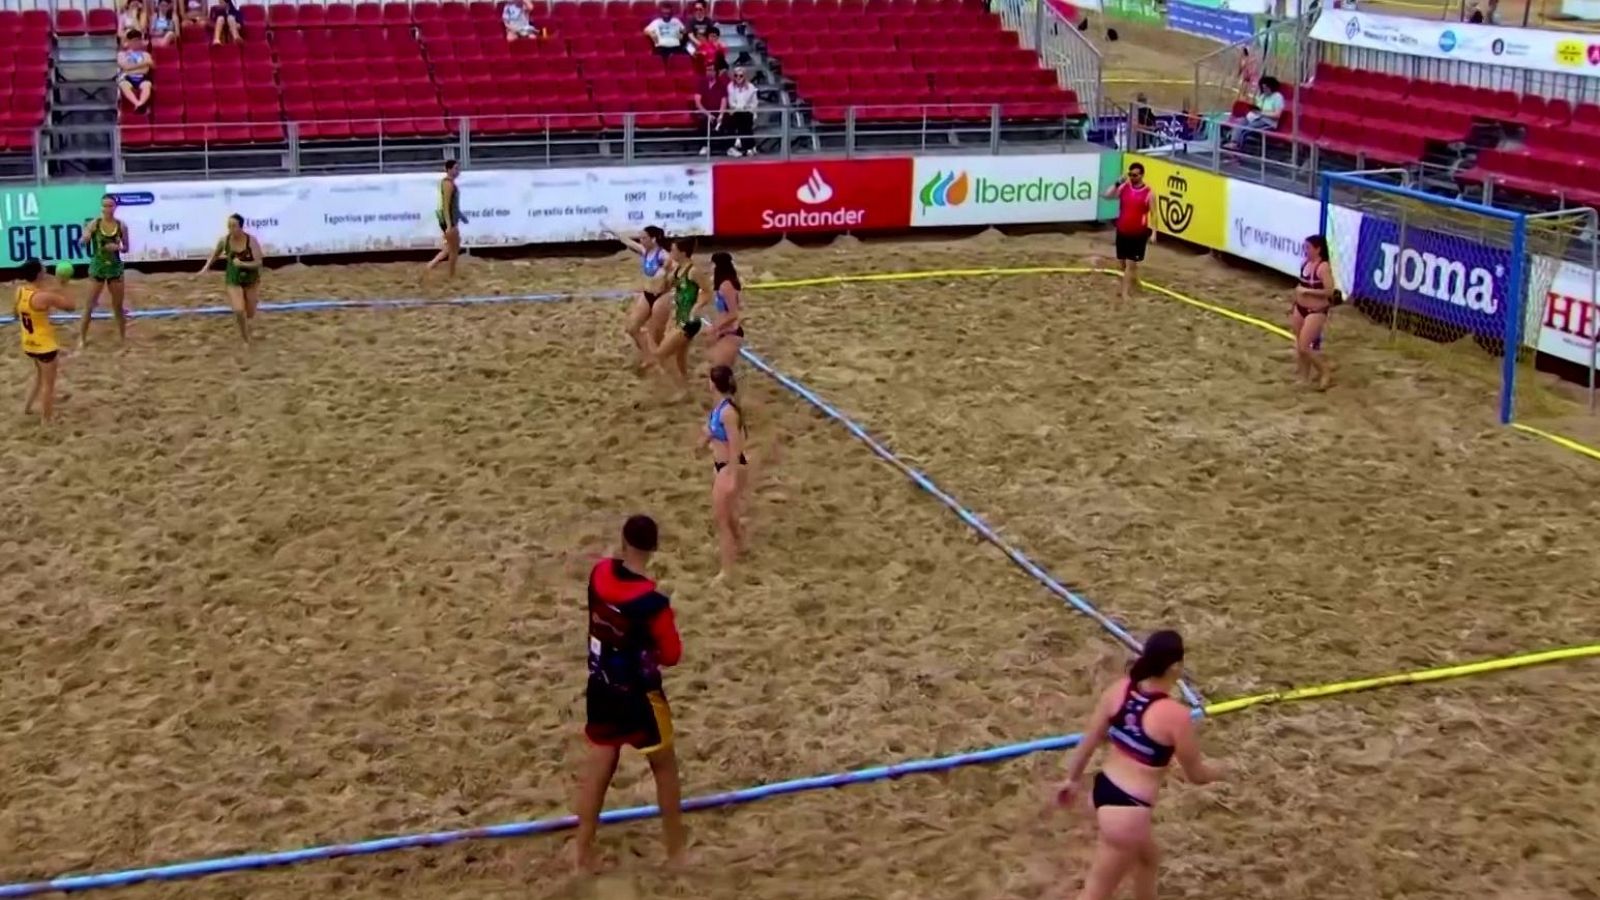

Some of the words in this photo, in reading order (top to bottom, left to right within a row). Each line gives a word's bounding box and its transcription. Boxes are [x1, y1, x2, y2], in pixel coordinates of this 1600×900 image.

[975, 176, 1092, 204] Iberdrola
[18, 192, 39, 220] LA
[761, 207, 865, 229] Santander
[1254, 228, 1309, 257] INFINITU
